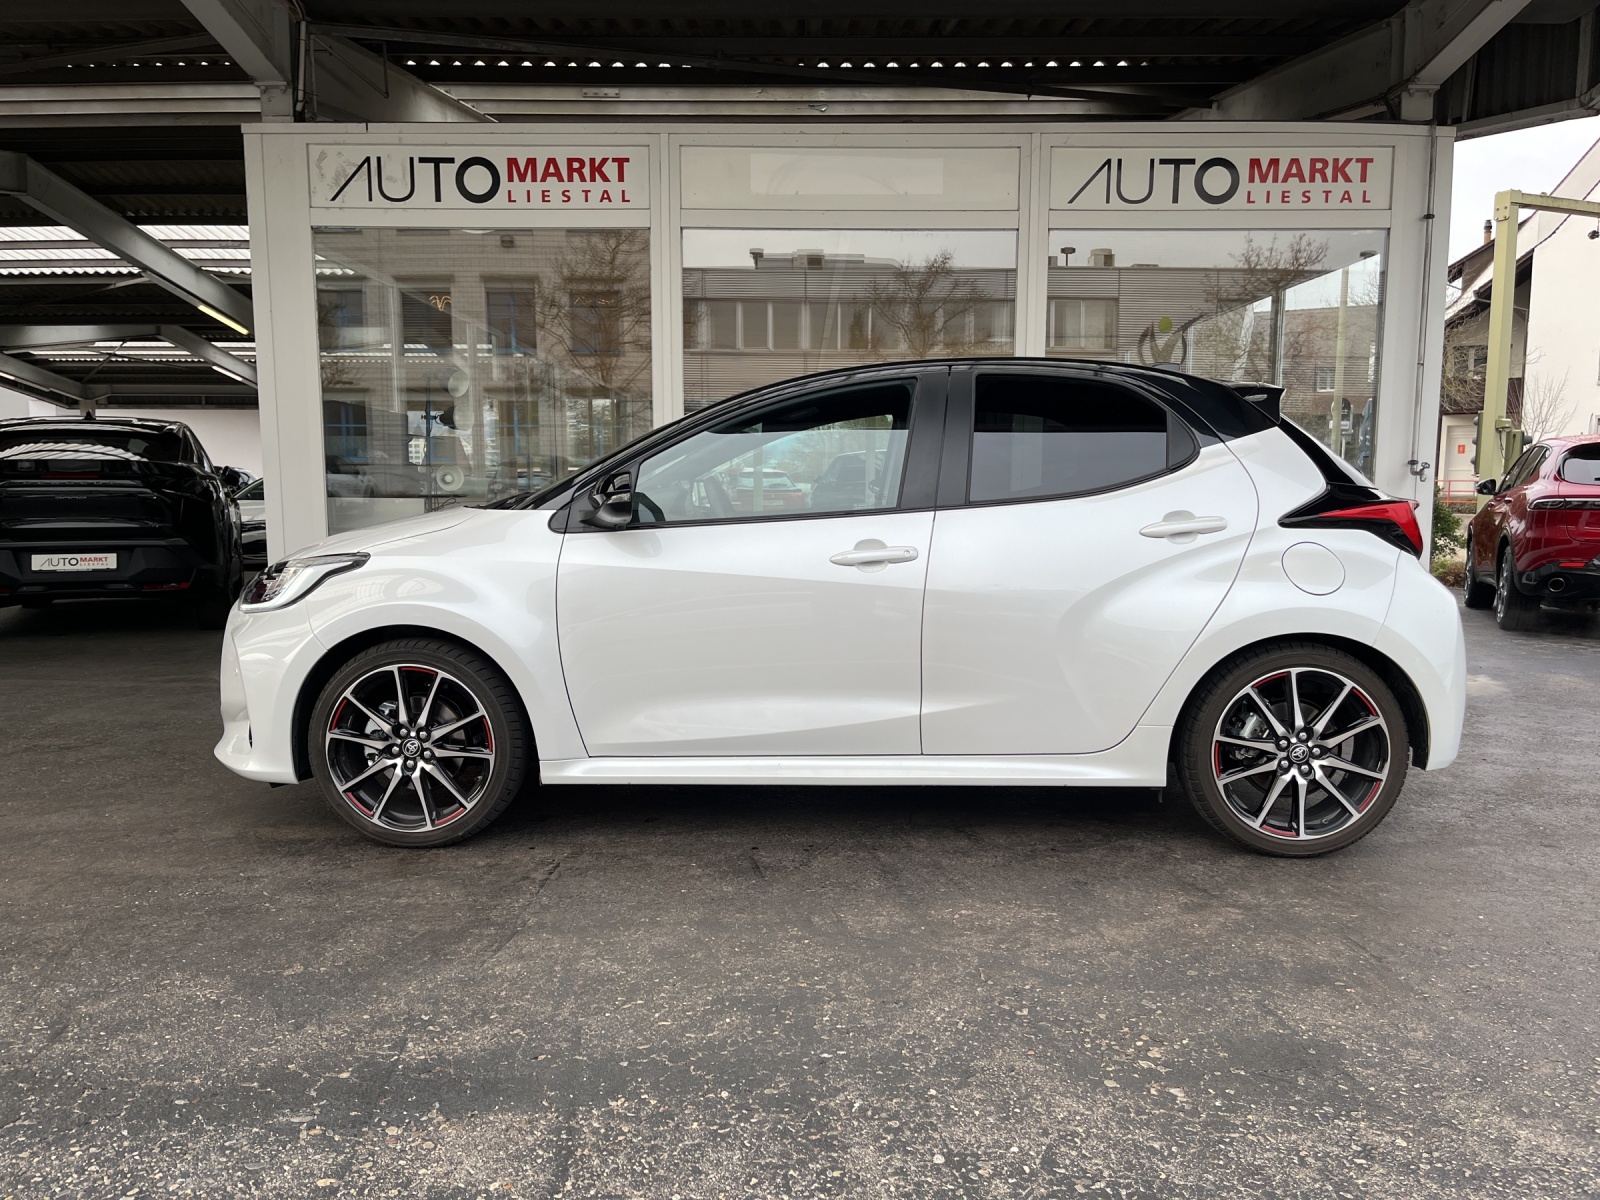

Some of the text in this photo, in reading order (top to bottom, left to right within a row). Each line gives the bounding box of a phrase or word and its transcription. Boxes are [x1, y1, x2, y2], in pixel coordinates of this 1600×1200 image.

[330, 156, 631, 204] AUTO MARKT
[1067, 157, 1374, 205] AUTO MARKT
[507, 189, 631, 203] LIESTAL
[1246, 190, 1372, 204] LIESTAL
[40, 557, 79, 567] AUTO
